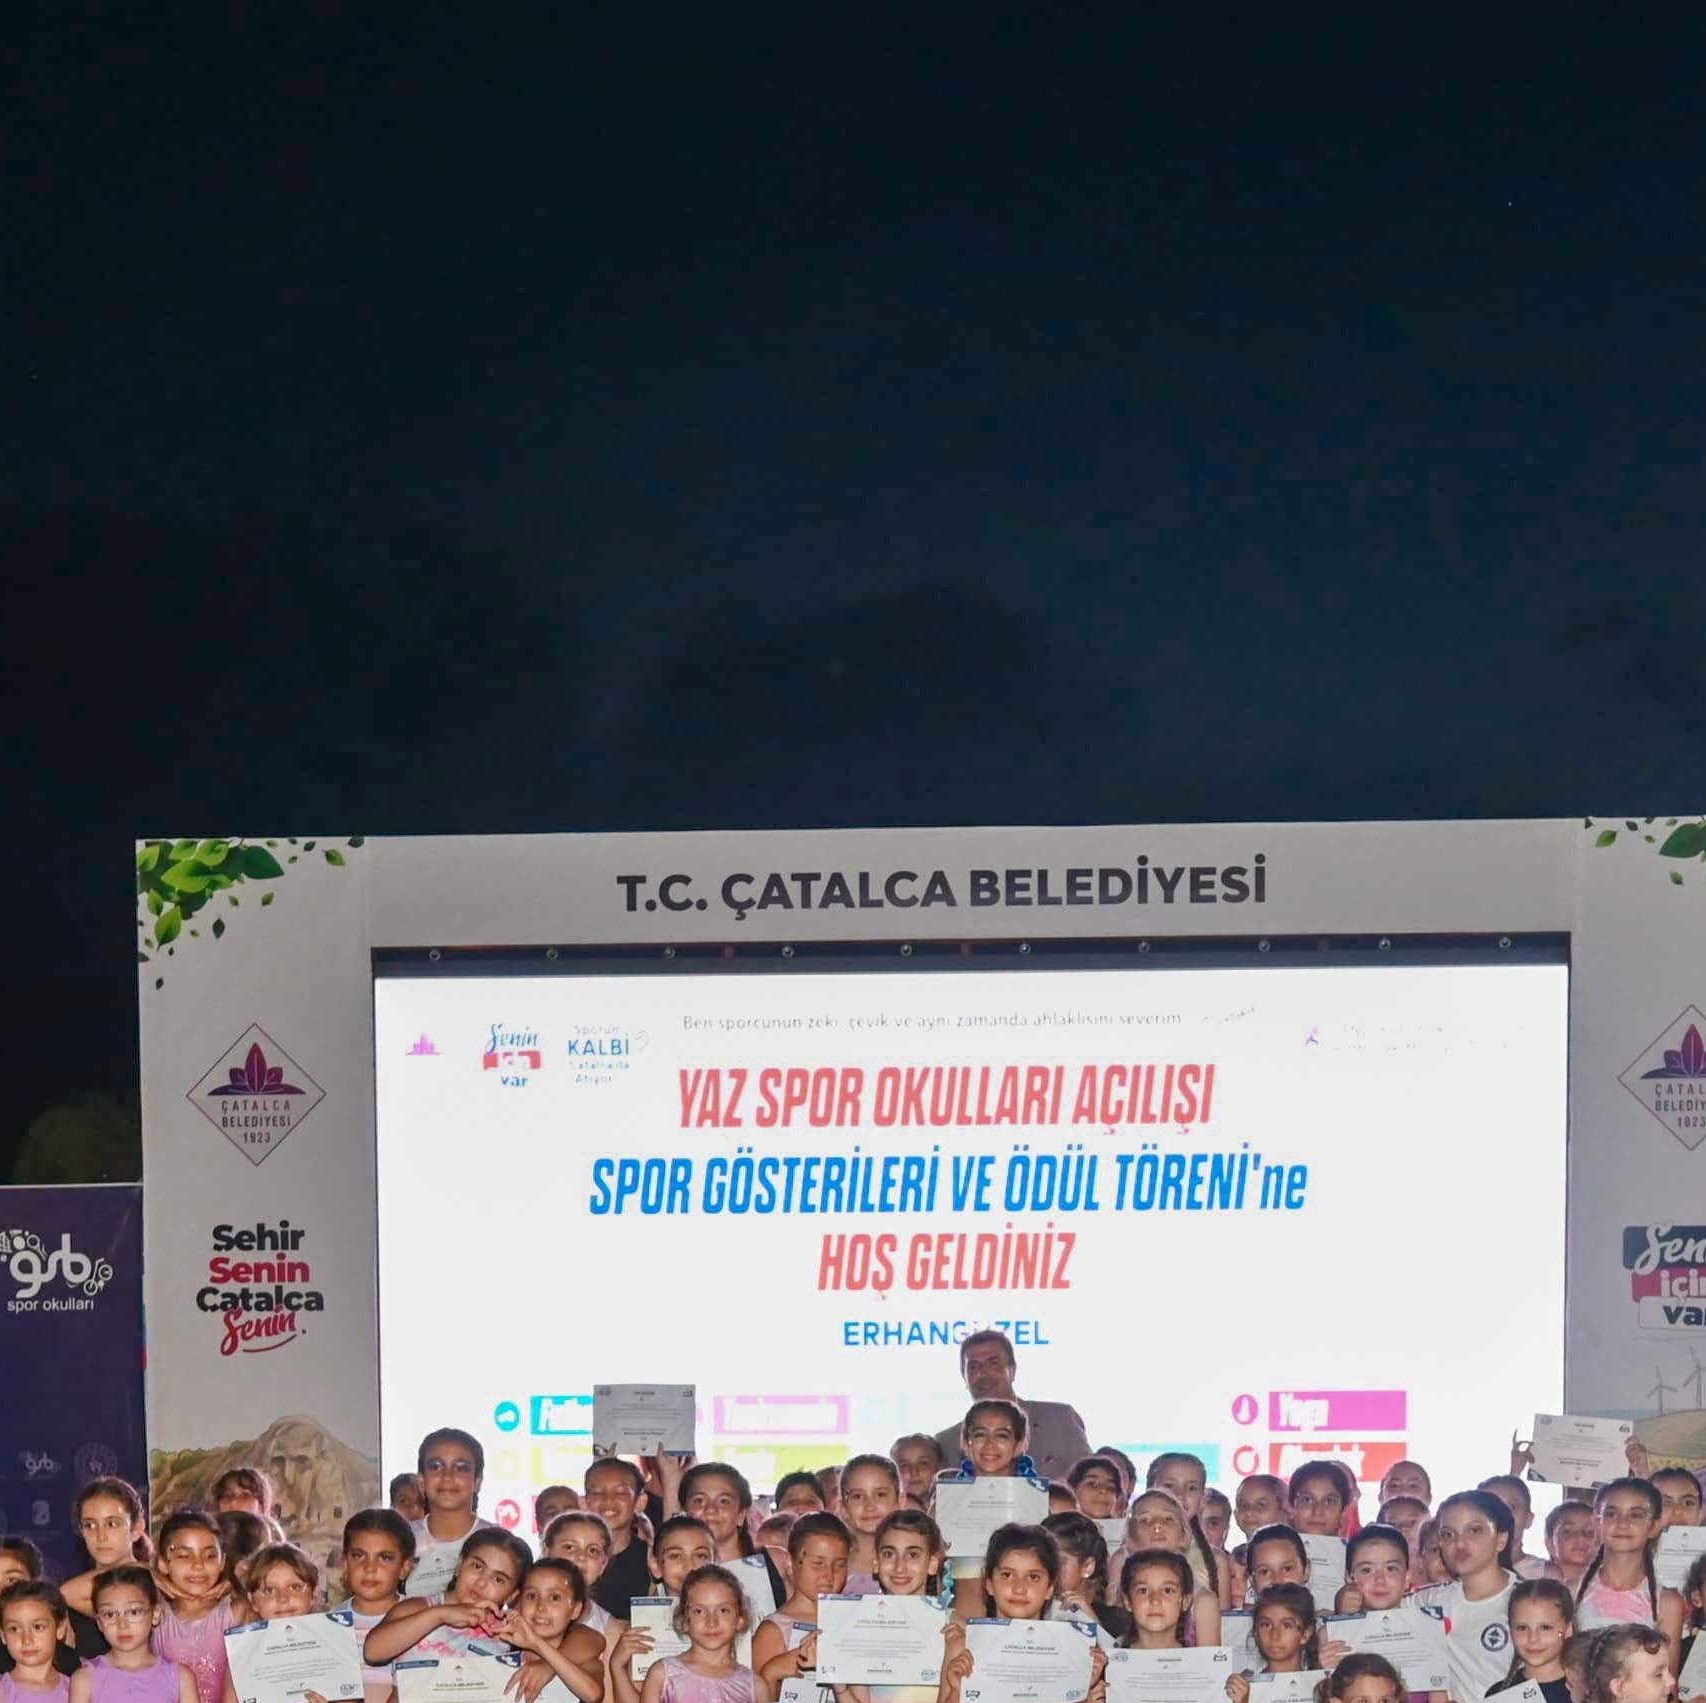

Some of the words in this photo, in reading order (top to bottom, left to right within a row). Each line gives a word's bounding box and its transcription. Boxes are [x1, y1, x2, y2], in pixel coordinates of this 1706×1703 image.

[617, 875, 707, 911] T.C.
[721, 871, 957, 921] ÇATALCA
[969, 854, 1266, 907] BELEDİYESİ
[568, 1033, 630, 1056] KALBİ
[500, 1074, 529, 1088] var
[221, 1100, 291, 1114] ÇATALCA
[678, 1067, 748, 1129] YAZ
[755, 1066, 861, 1128] SPOR
[873, 1064, 1062, 1126] OKULLARI
[1072, 1063, 1215, 1135] AÇILIŞI
[221, 1115, 291, 1128] BELEDİYESİ
[1677, 1116, 1706, 1128] 1923
[590, 1156, 692, 1216] SPOR
[703, 1144, 940, 1214] GÖSTERİLERİ
[953, 1154, 994, 1213] VE
[1004, 1145, 1099, 1213] ÖDÜL
[1115, 1142, 1309, 1212] TÖRENİ'ne
[9, 1233, 93, 1299] gsb
[209, 1253, 310, 1284] Senin
[818, 1233, 896, 1301] HOŞ
[906, 1221, 1077, 1291] GELDİNİZ
[7, 1300, 39, 1315] spor
[43, 1297, 94, 1312] okulları
[196, 1285, 324, 1313] Çatalca
[844, 1320, 1049, 1346] ERHANGZEL
